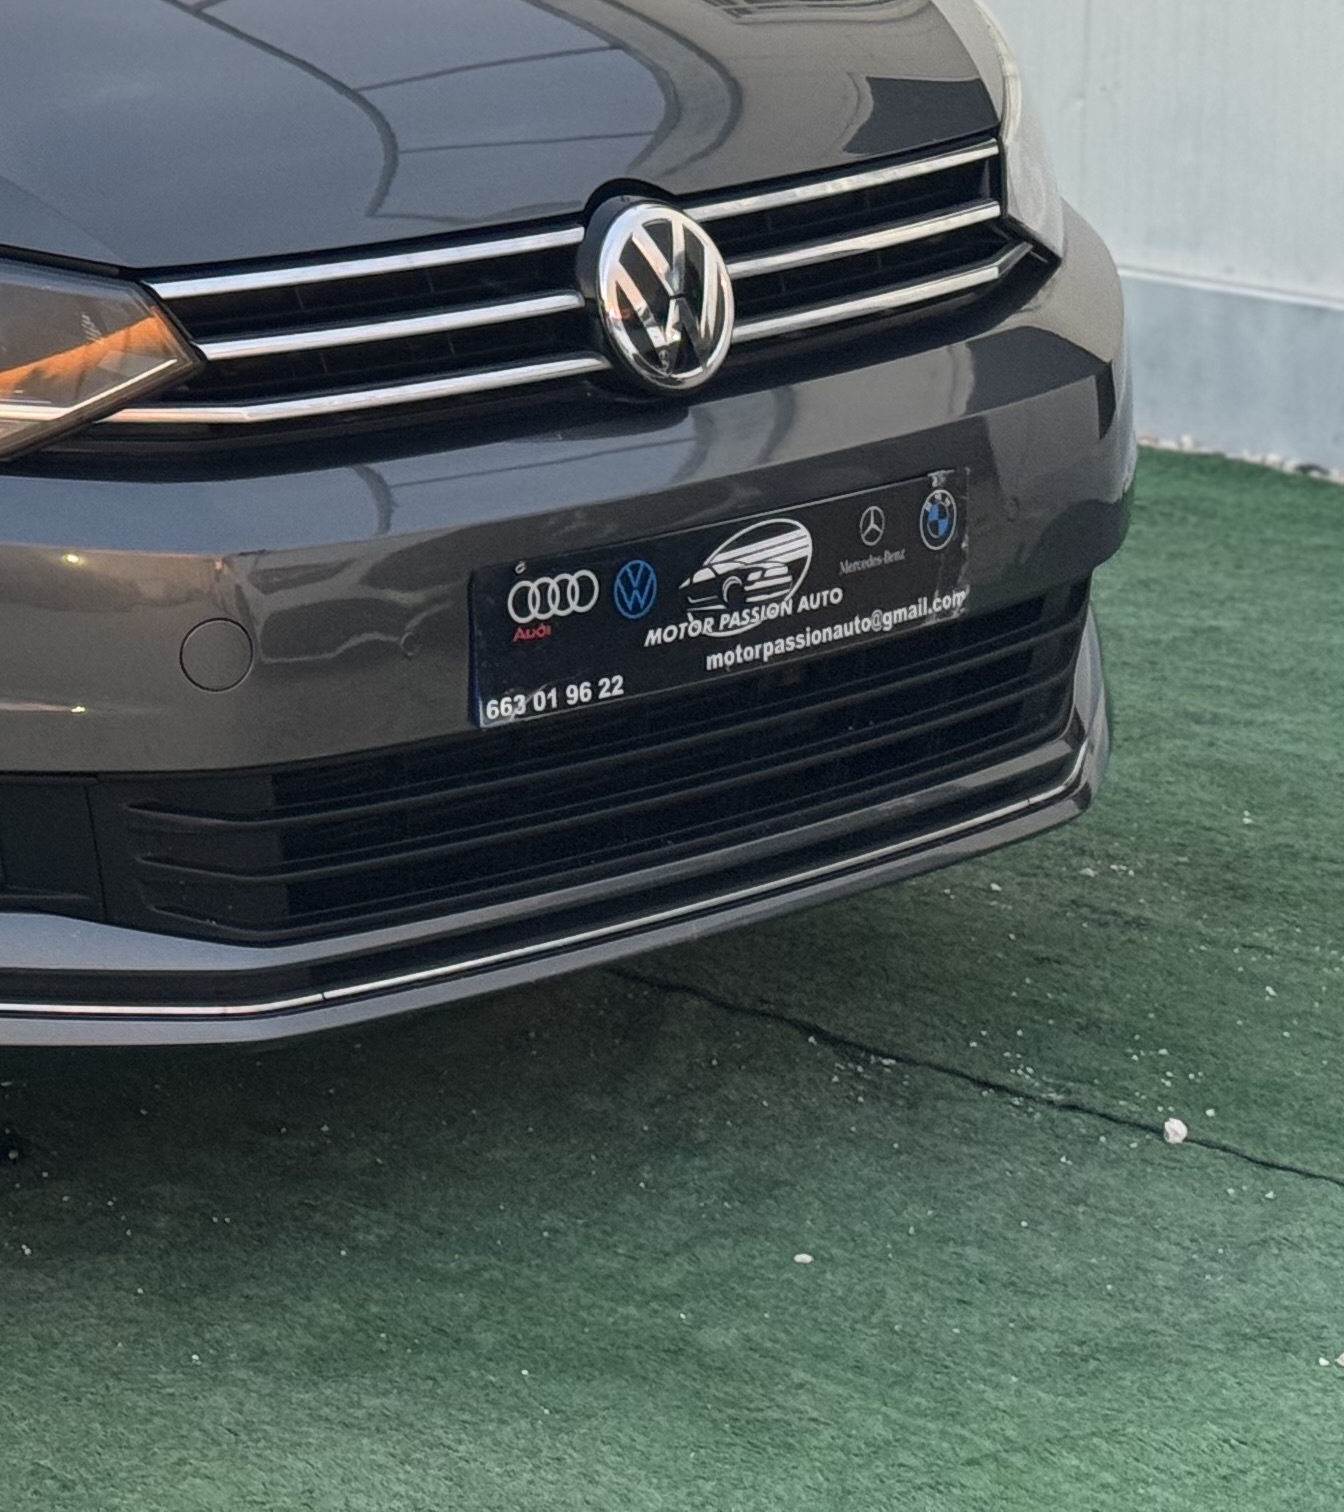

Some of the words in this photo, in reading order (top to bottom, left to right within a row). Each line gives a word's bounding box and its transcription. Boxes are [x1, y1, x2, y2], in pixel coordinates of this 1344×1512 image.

[512, 623, 552, 642] Audi
[643, 616, 715, 647] MOTOR
[718, 598, 793, 631] PASSION
[796, 587, 843, 613] AUTO
[706, 589, 967, 671] motorpassionauto@gmail.com
[486, 694, 526, 720] 663
[533, 687, 558, 712] 01
[565, 681, 592, 706] 96
[598, 674, 625, 699] 22
